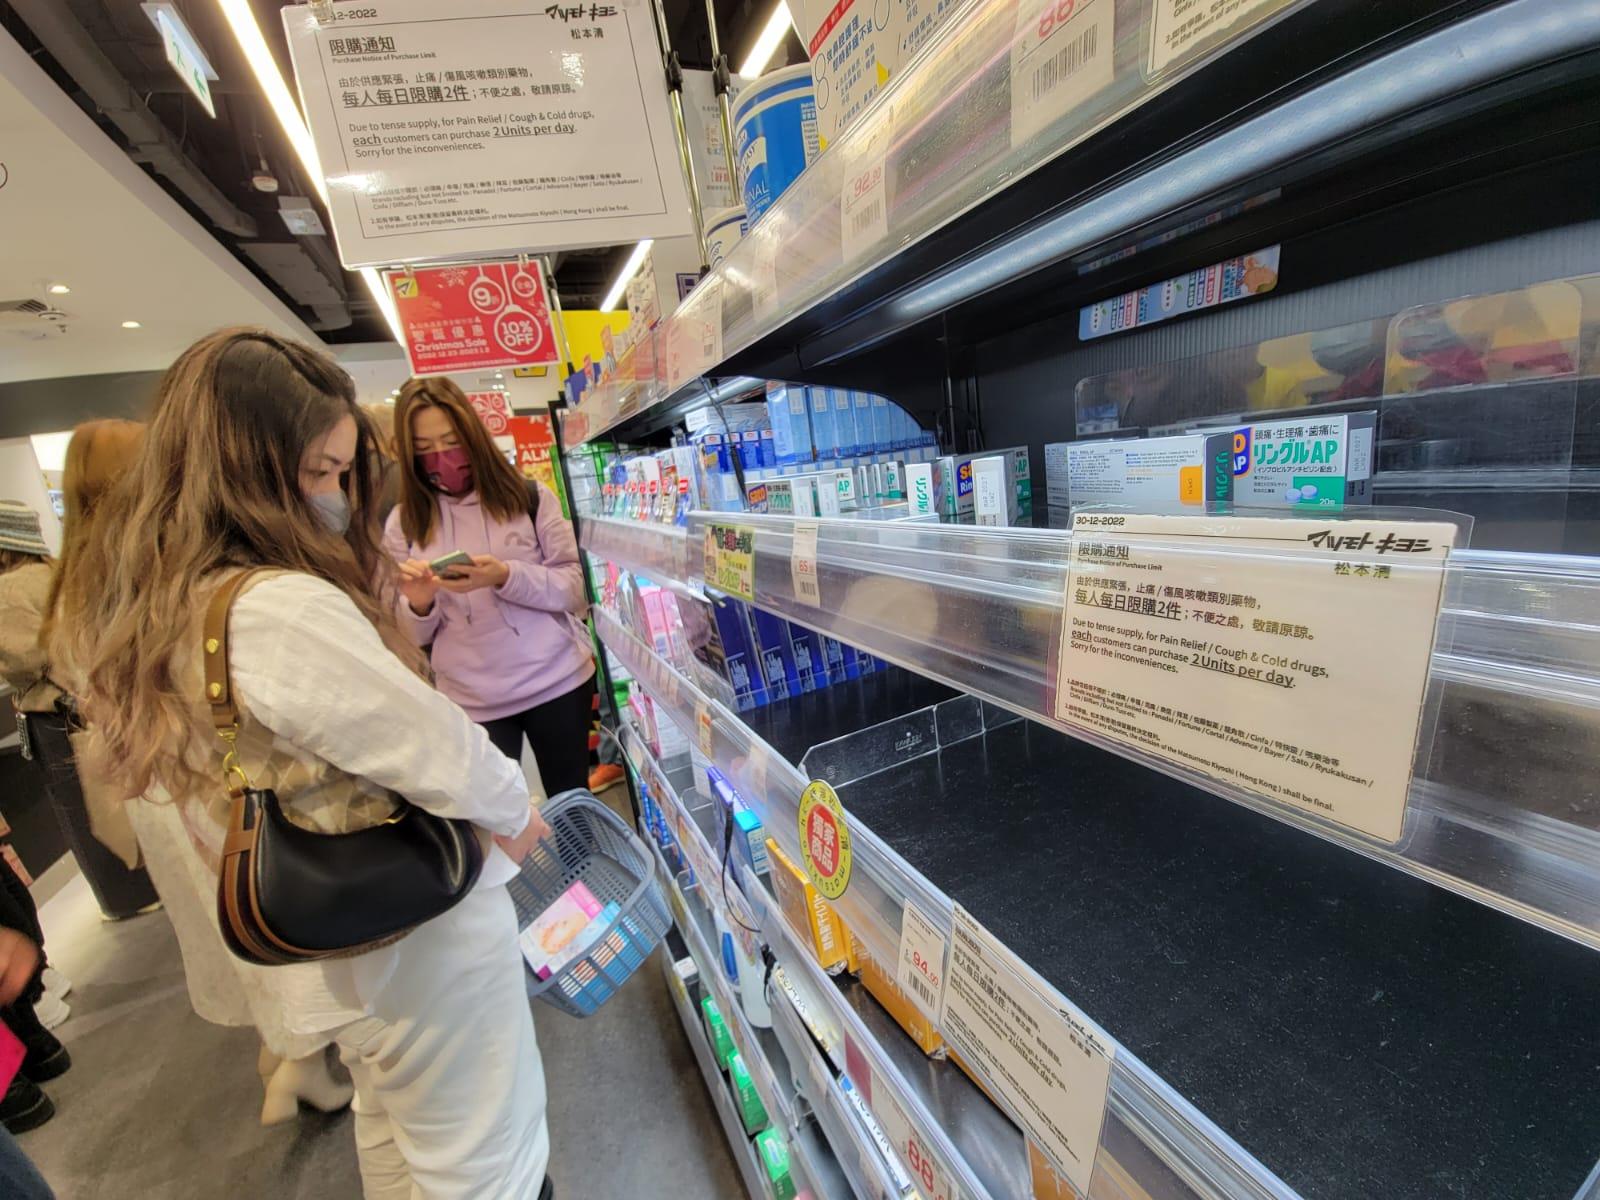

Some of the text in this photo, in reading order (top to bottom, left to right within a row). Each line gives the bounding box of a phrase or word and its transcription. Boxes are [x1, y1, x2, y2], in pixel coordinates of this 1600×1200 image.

[328, 35, 396, 55] 限購通知
[348, 122, 367, 131] Due
[368, 122, 379, 130] to
[380, 120, 406, 129] tense
[406, 117, 440, 130] supply,
[441, 116, 454, 125] for
[456, 115, 476, 125] Pain
[476, 113, 502, 124] Relief
[508, 112, 537, 124] Cough
[545, 110, 566, 119] Cold
[567, 108, 594, 120] drugs,
[351, 121, 577, 146] each customers can purchase 2 Units per day.
[354, 140, 485, 159] Sorry for the inconveniences.
[501, 320, 533, 335] 10%
[415, 337, 487, 353] Christmas Sale
[503, 333, 533, 347] OFF
[1076, 516, 1125, 526] 30-12-2022
[1078, 542, 1129, 560] 限購通知
[1122, 561, 1146, 570] Purchase
[1147, 563, 1162, 571] Limit
[1335, 562, 1391, 579] 松本清
[1070, 641, 1179, 673] Sorry for the inconveniences.
[1072, 617, 1329, 679] Due to tense supply, for Pain Relief / Cough & Cold drugs,
[1071, 627, 1297, 689] each customers can purchase 2 Units per day.
[1229, 736, 1257, 751] Advance
[1263, 746, 1284, 760] Bayer
[1290, 755, 1309, 767] Sato
[1314, 762, 1367, 787] Ryukakusan
[1008, 1034, 1012, 1043] 2
[1012, 1038, 1028, 1060] Units
[1028, 1057, 1039, 1073] per
[1040, 1068, 1053, 1089] day.
[1039, 1058, 1050, 1073] Cold
